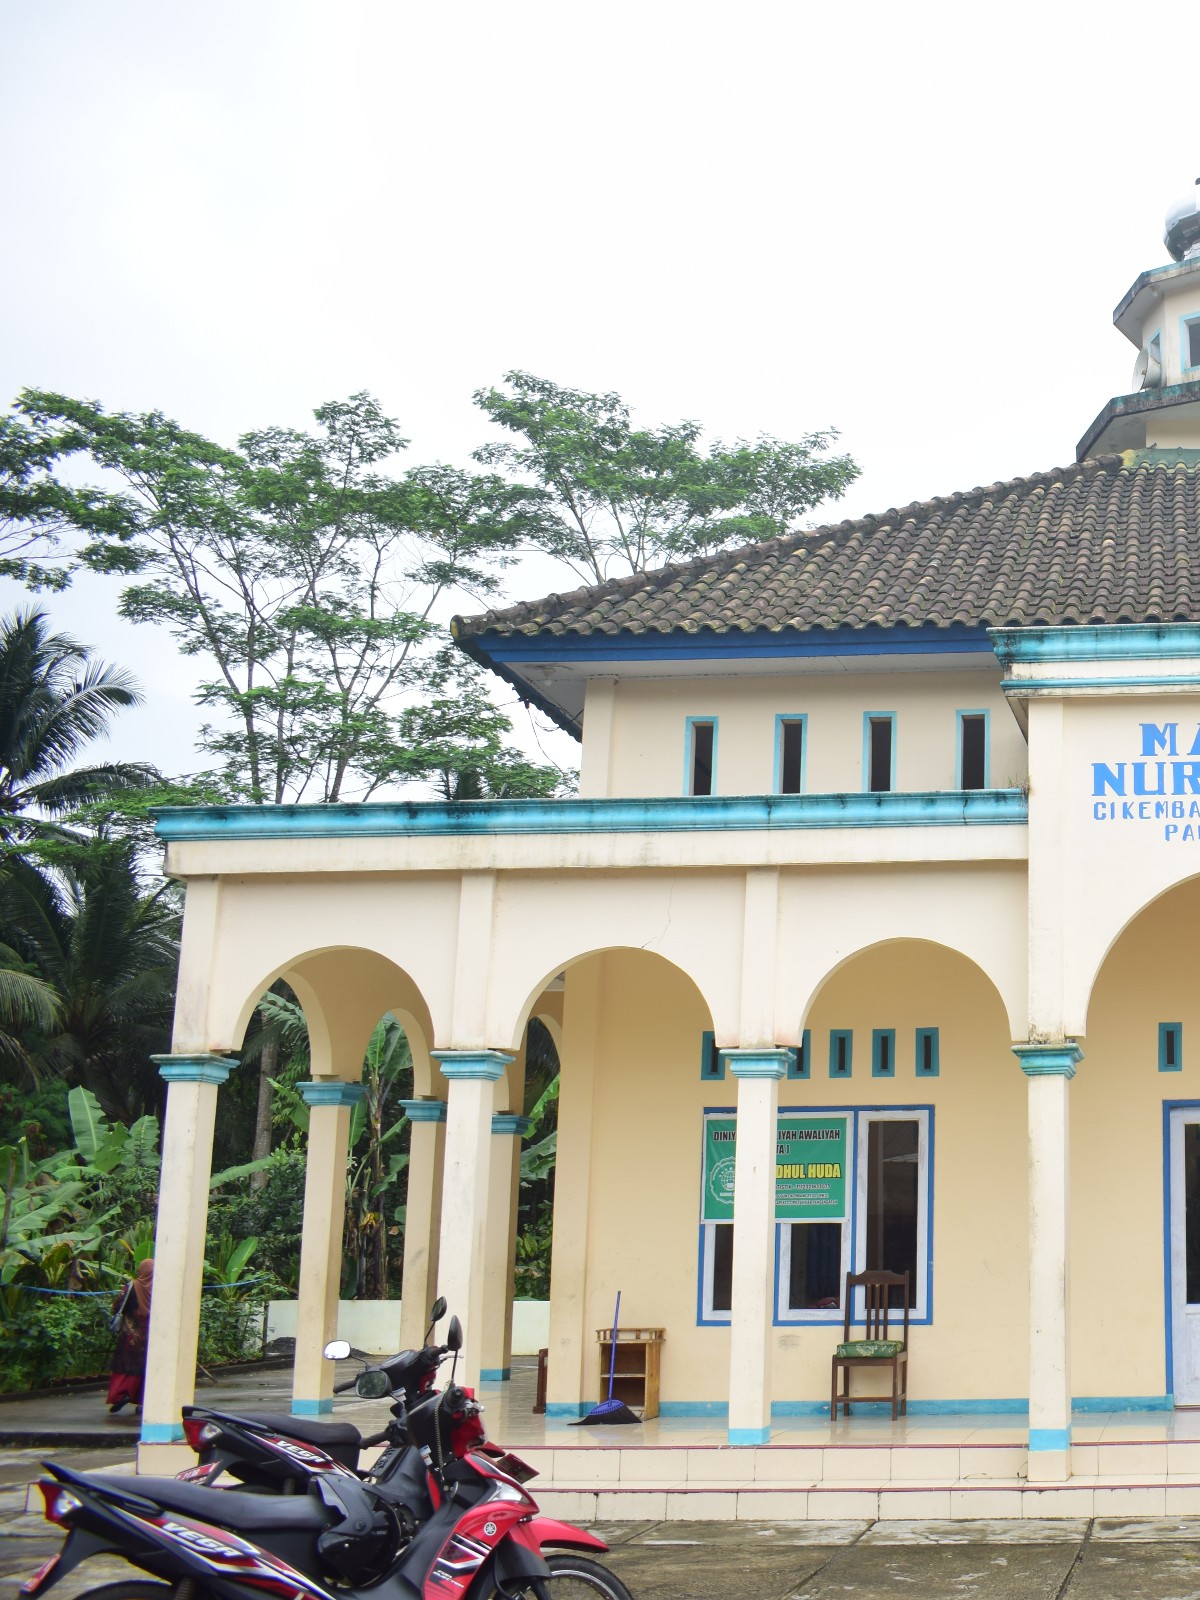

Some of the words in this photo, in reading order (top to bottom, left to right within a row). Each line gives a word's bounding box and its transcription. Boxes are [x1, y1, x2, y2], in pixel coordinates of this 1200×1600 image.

[799, 1129, 840, 1140] AWALIYAH
[807, 1163, 841, 1178] HUDA
[276, 1440, 327, 1463] VEGA
[162, 1522, 244, 1557] VEGA
